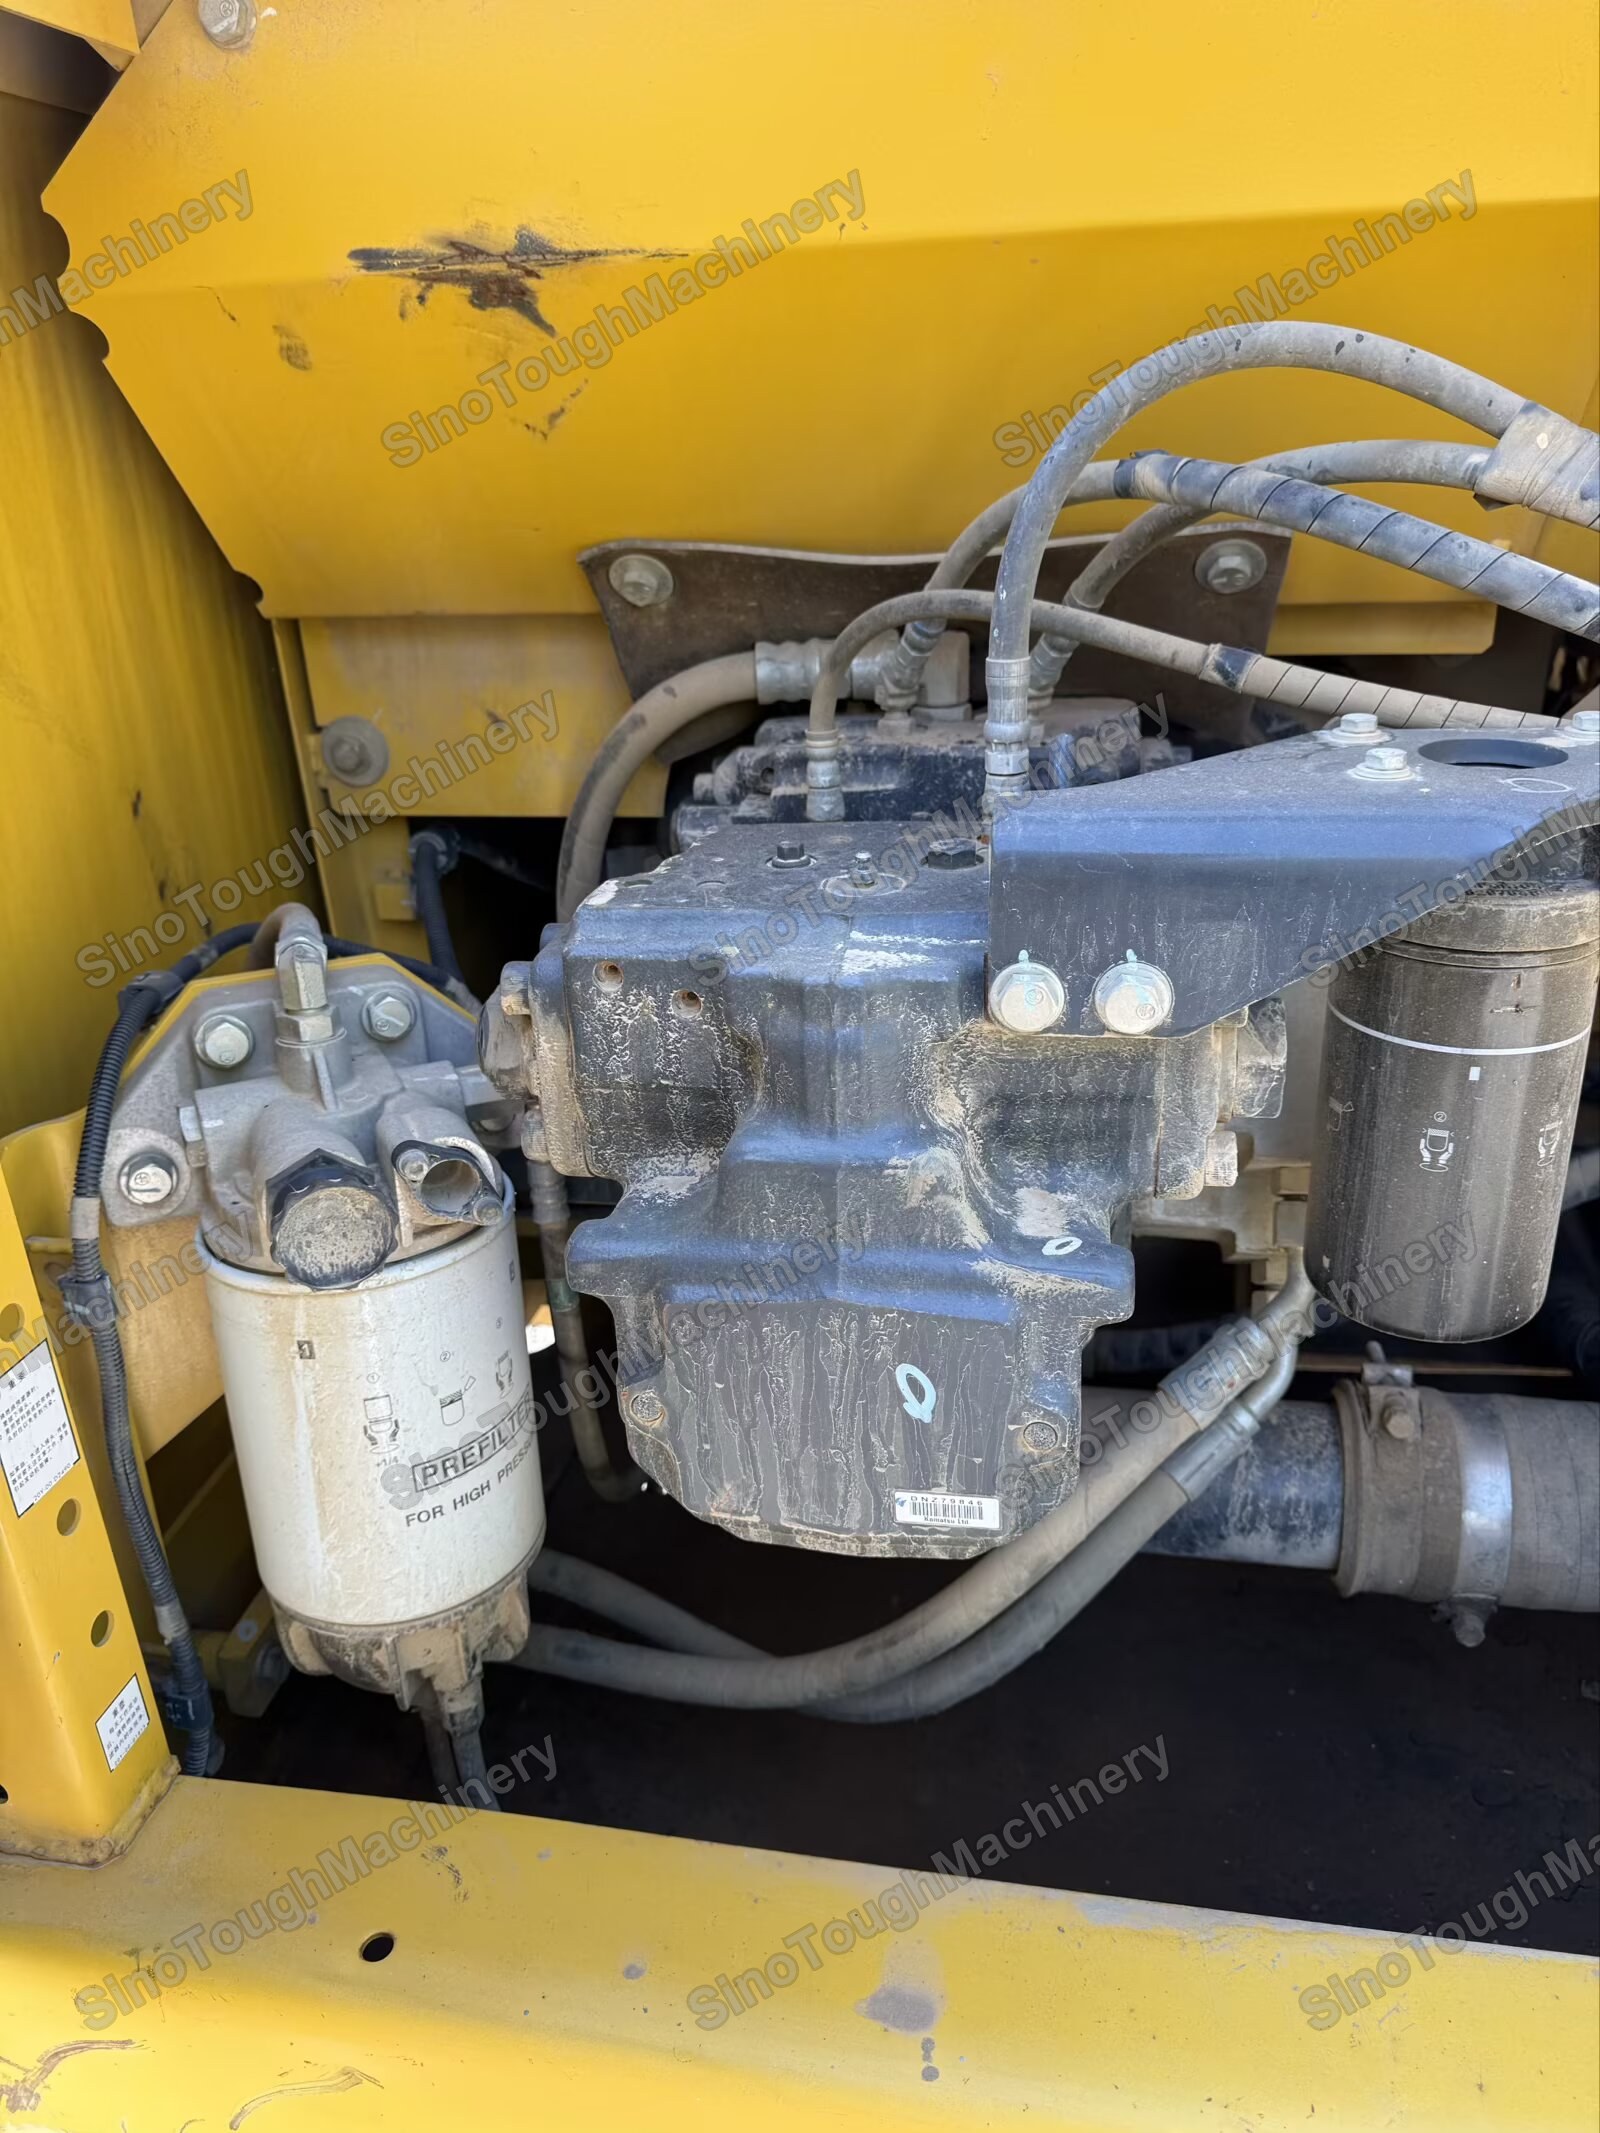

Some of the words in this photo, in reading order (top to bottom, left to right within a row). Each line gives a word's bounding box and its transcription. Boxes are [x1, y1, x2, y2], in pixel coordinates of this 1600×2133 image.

[405, 1504, 445, 1527] FOR
[453, 1479, 491, 1511] HIGH
[910, 1495, 983, 1506] DNZ79846
[924, 1516, 955, 1524] Komatsu
